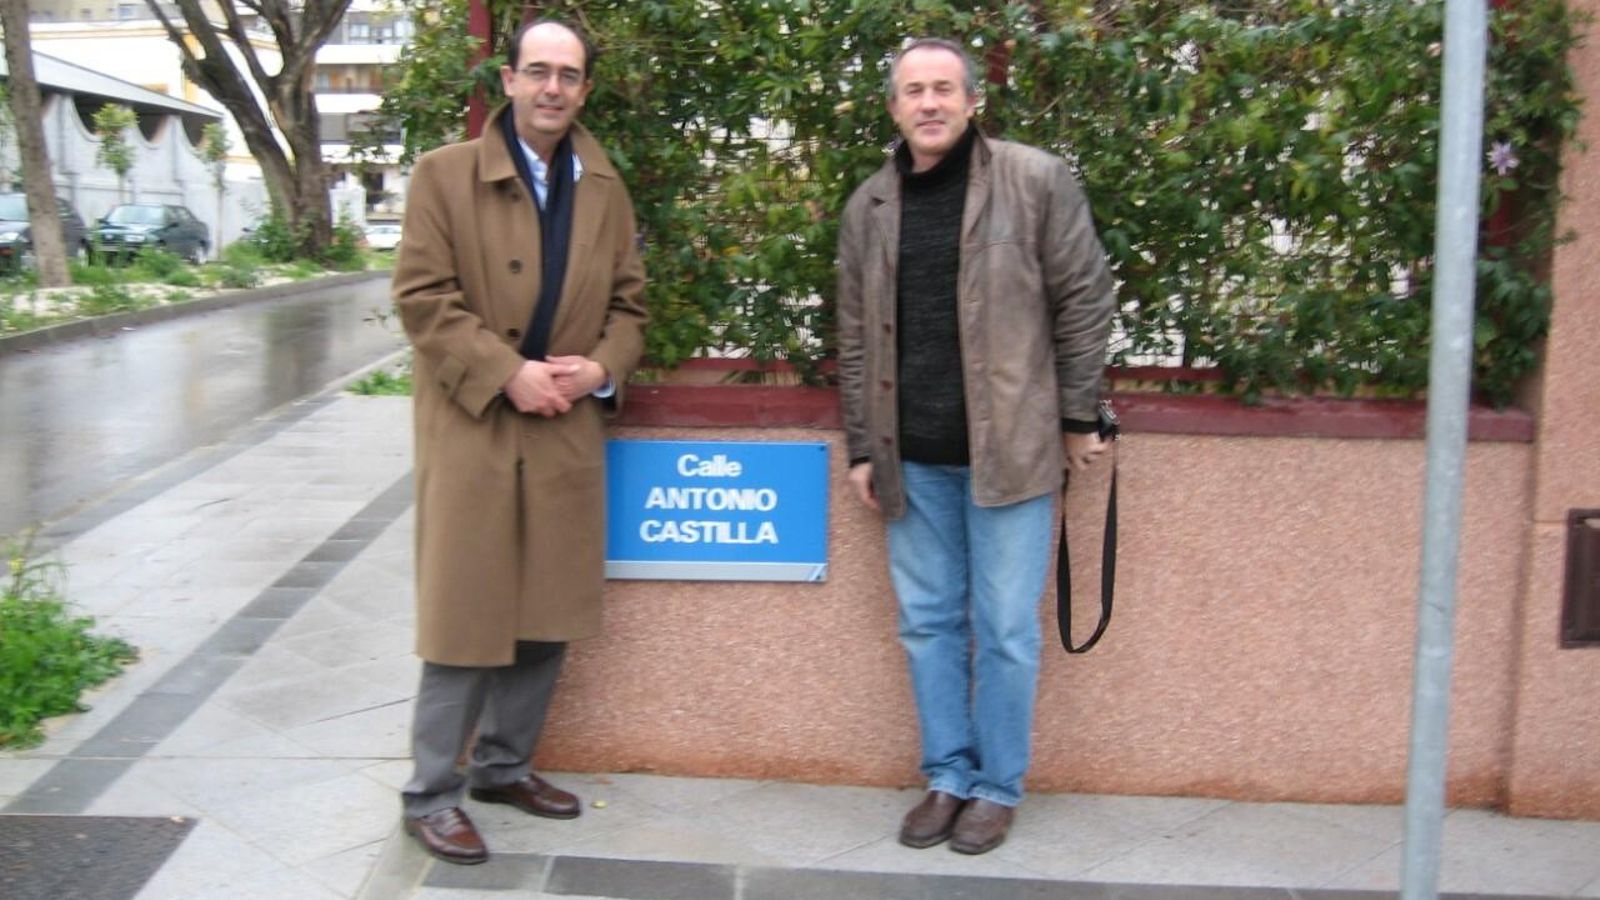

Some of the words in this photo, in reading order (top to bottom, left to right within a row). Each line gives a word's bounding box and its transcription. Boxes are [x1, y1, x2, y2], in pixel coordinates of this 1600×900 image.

[677, 454, 742, 478] Calle
[645, 487, 777, 512] ANTONIO
[639, 519, 778, 545] CASTILLA
